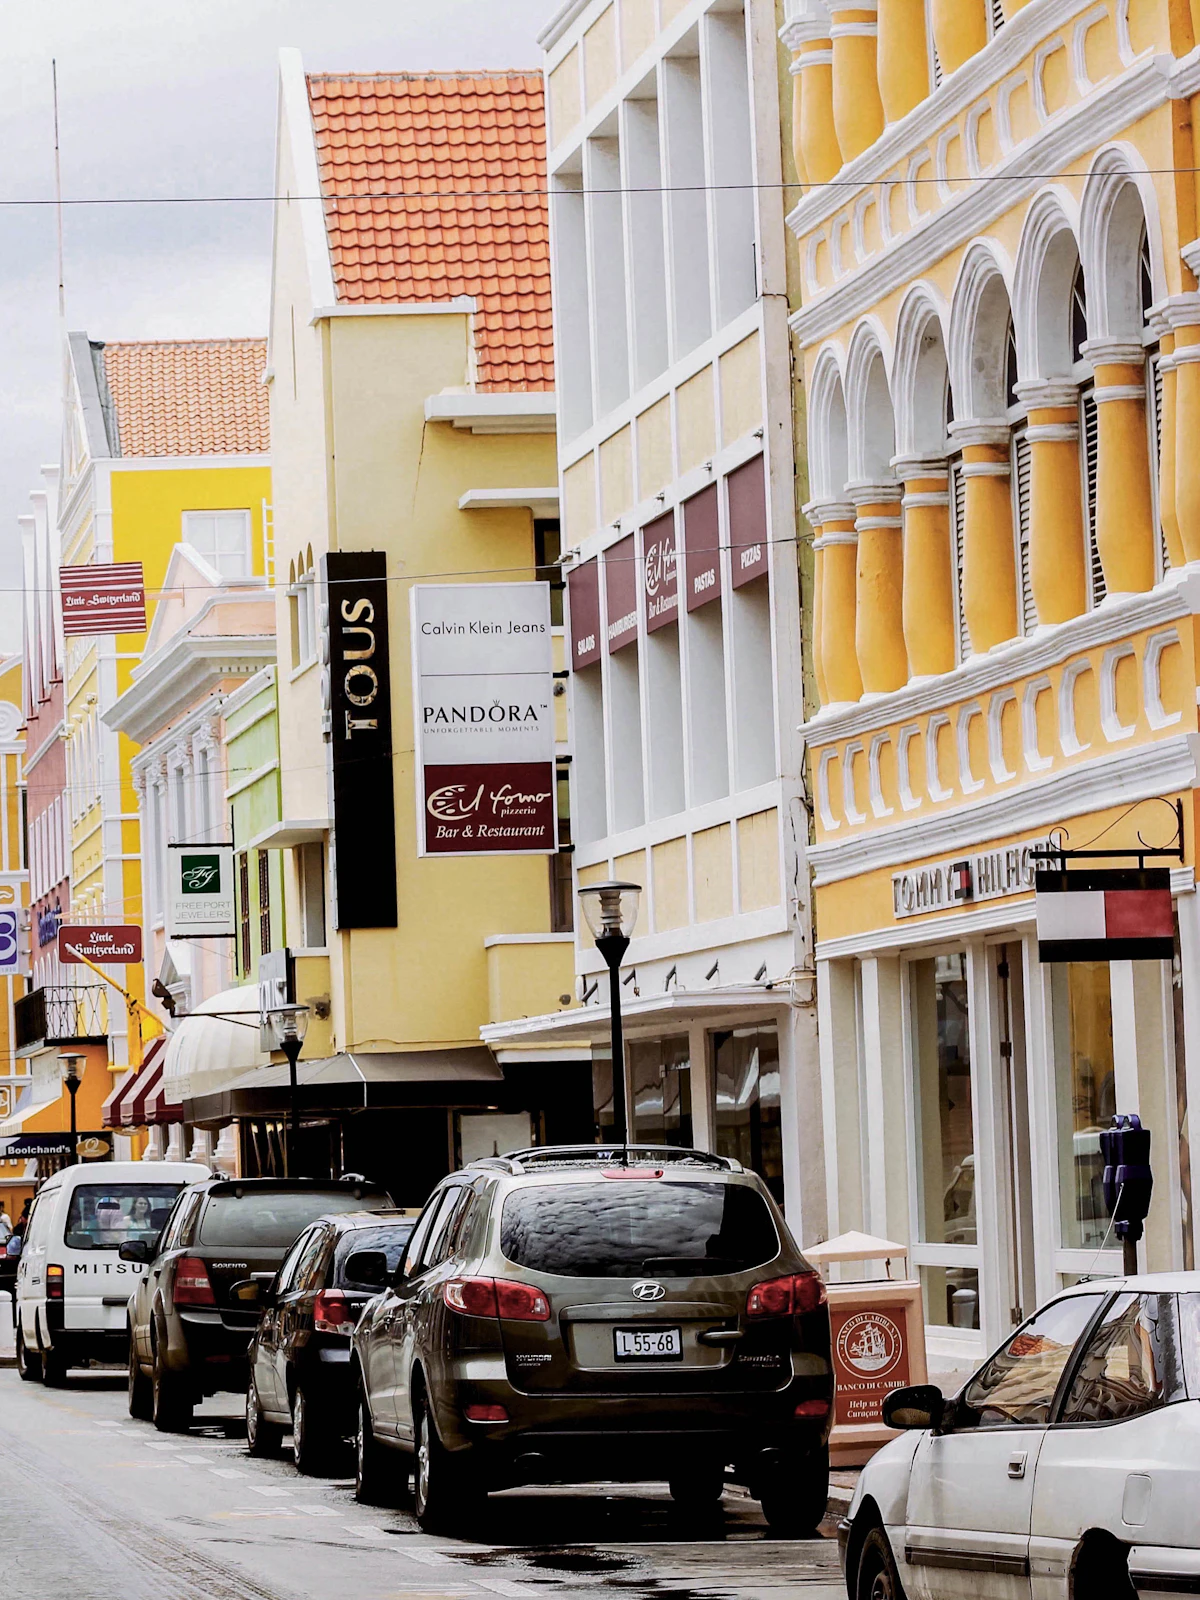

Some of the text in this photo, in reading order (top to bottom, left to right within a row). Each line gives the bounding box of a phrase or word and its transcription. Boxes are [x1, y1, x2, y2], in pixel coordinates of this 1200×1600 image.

[740, 545, 761, 569] PIZZAS
[694, 569, 715, 594] PASTAS
[65, 592, 141, 606] Little Switzerland
[421, 620, 546, 635] Calvin Klein Jeans
[578, 635, 595, 656] SALADS
[341, 598, 378, 740] TOUS
[423, 704, 538, 723] PANDORA
[501, 806, 536, 818] pizzeria
[436, 824, 545, 838] Bar & Restaurant
[891, 864, 954, 913] TOMMY
[176, 911, 231, 919] JEWELERS
[88, 932, 114, 943] Little
[7, 1145, 71, 1155] Boolchand's
[634, 1334, 674, 1352] 55-68
[837, 1383, 865, 1391] BANCO
[877, 1380, 907, 1388] CARIBE
[849, 1400, 868, 1409] Help
[847, 1409, 878, 1418] Curaçao
